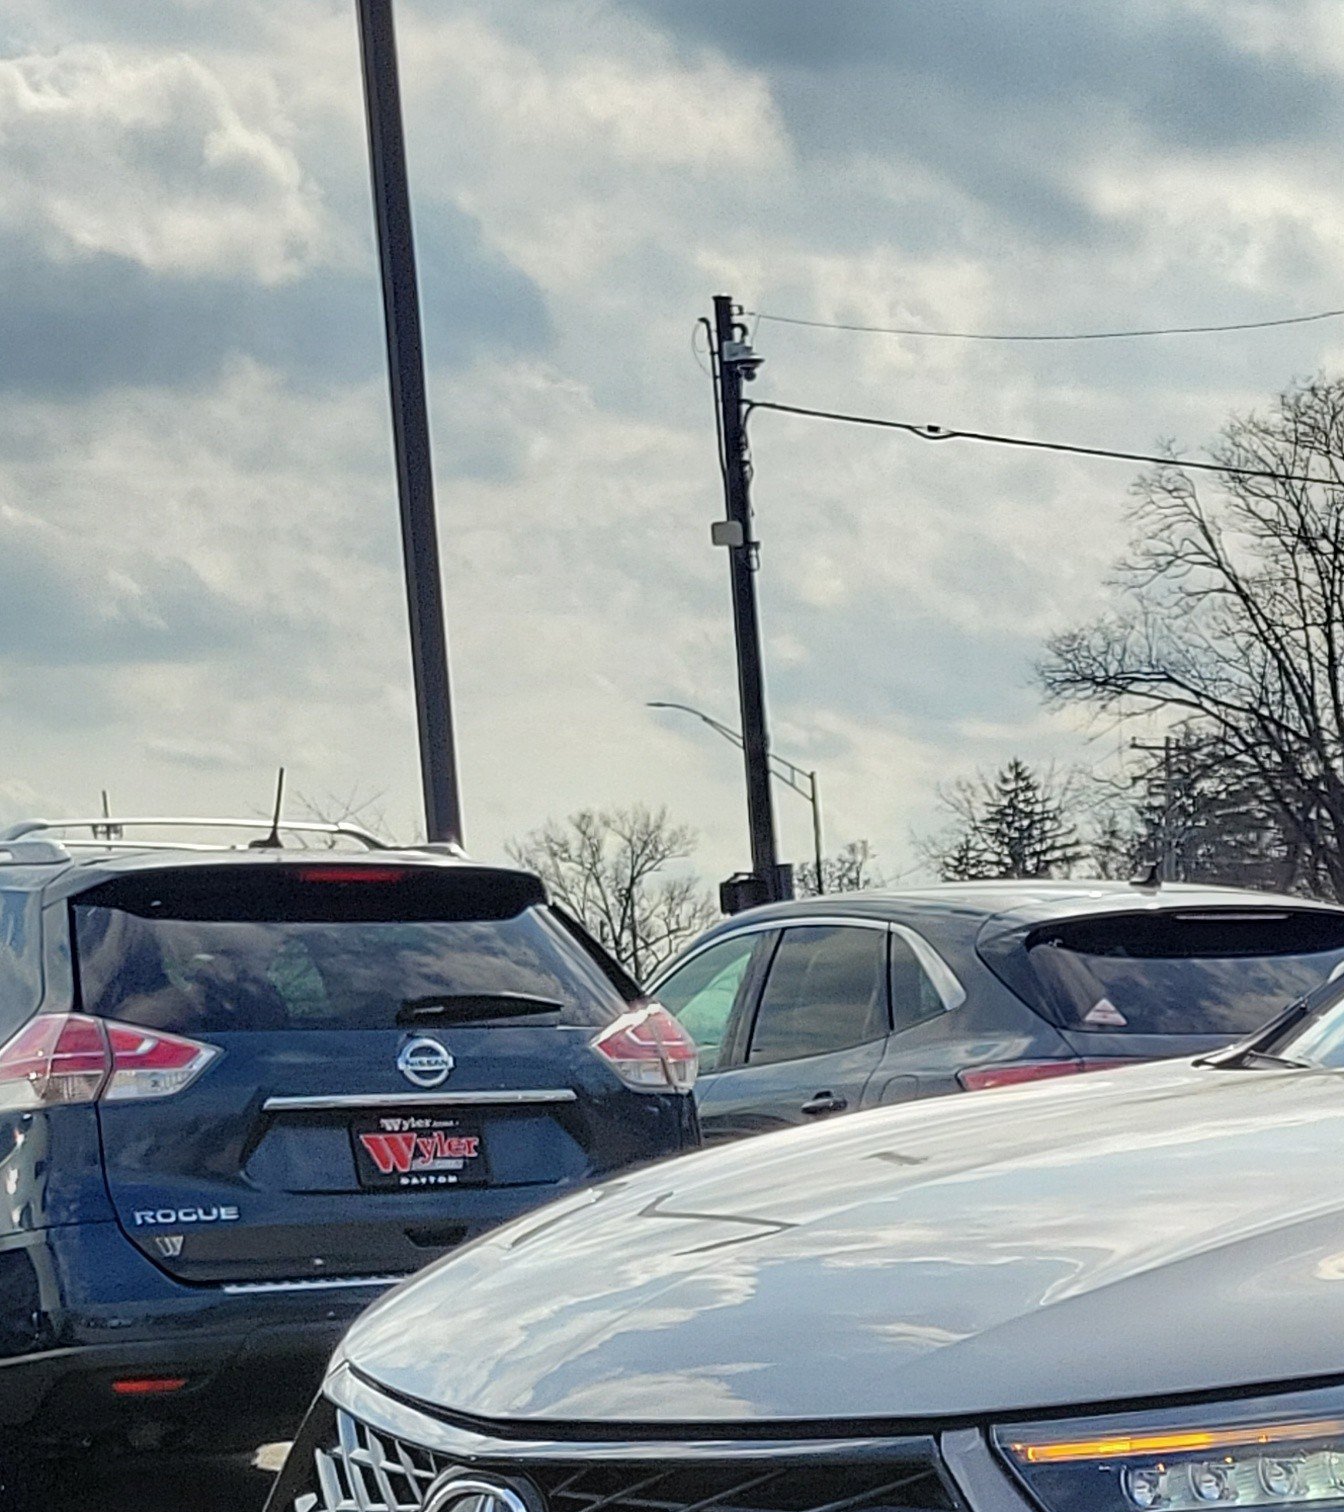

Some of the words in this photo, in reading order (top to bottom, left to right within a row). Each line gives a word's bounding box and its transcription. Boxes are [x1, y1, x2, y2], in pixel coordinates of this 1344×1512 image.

[380, 1117, 431, 1131] Wyler
[359, 1130, 479, 1173] Wyler
[134, 1206, 240, 1226] ROGUE
